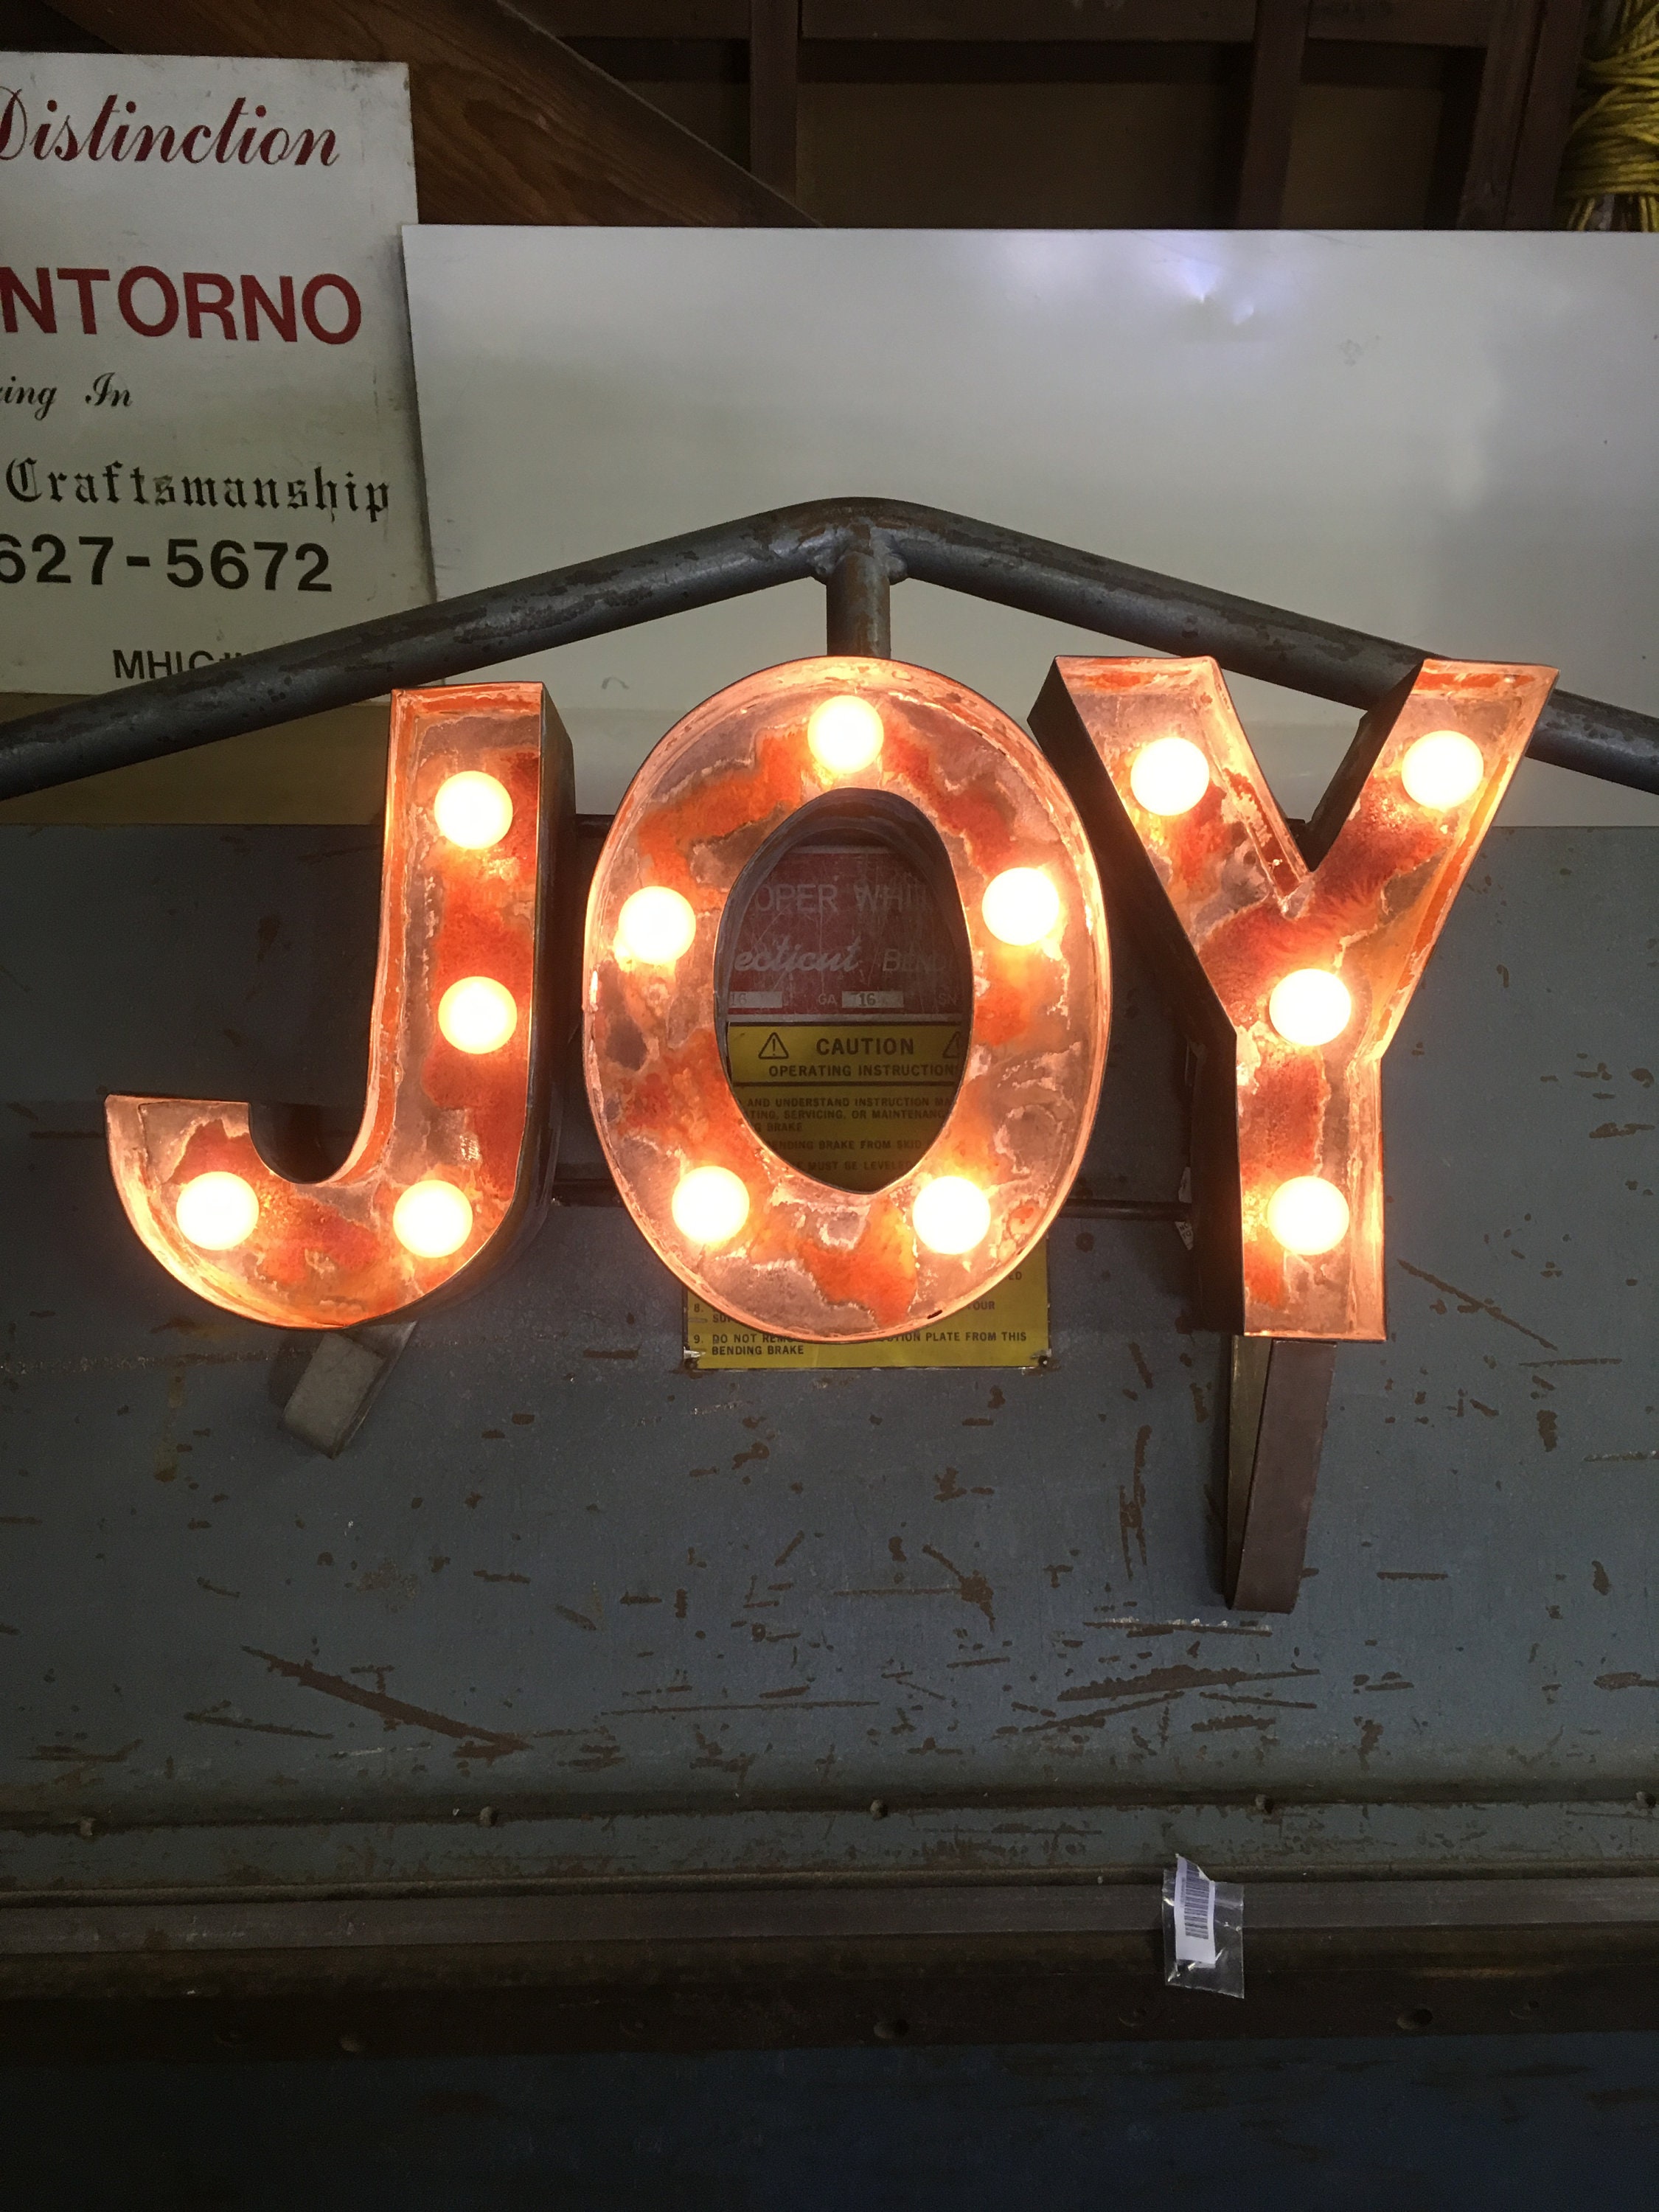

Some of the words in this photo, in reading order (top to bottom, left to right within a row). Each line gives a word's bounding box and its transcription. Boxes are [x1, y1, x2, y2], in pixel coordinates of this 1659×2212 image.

[0, 86, 340, 166] Distinction
[0, 265, 361, 344] NTORNO
[0, 375, 58, 421] ing
[85, 372, 133, 407] In
[6, 457, 390, 523] Craftsmanship
[0, 534, 333, 592] 627-5672
[106, 655, 1560, 1343] JOY
[815, 1038, 914, 1055] CAUTION
[768, 1065, 852, 1077] OPERATING
[747, 1098, 771, 1107] AND
[775, 1098, 849, 1107] UNDERSTAND
[855, 1097, 930, 1107] INSTRUCTION
[785, 1110, 846, 1120] SERVICING,
[852, 1110, 867, 1120] OR
[767, 1122, 803, 1133] BRAKE
[818, 1141, 855, 1150] BRAKE
[693, 1335, 704, 1344] 9.
[712, 1334, 728, 1344] DO
[734, 1333, 758, 1343] NOT
[925, 1332, 960, 1342] PLATE
[964, 1332, 998, 1342] FROM
[1001, 1332, 1027, 1342] THIS
[712, 1345, 762, 1355] BENDING
[767, 1345, 804, 1354] BRAKE
